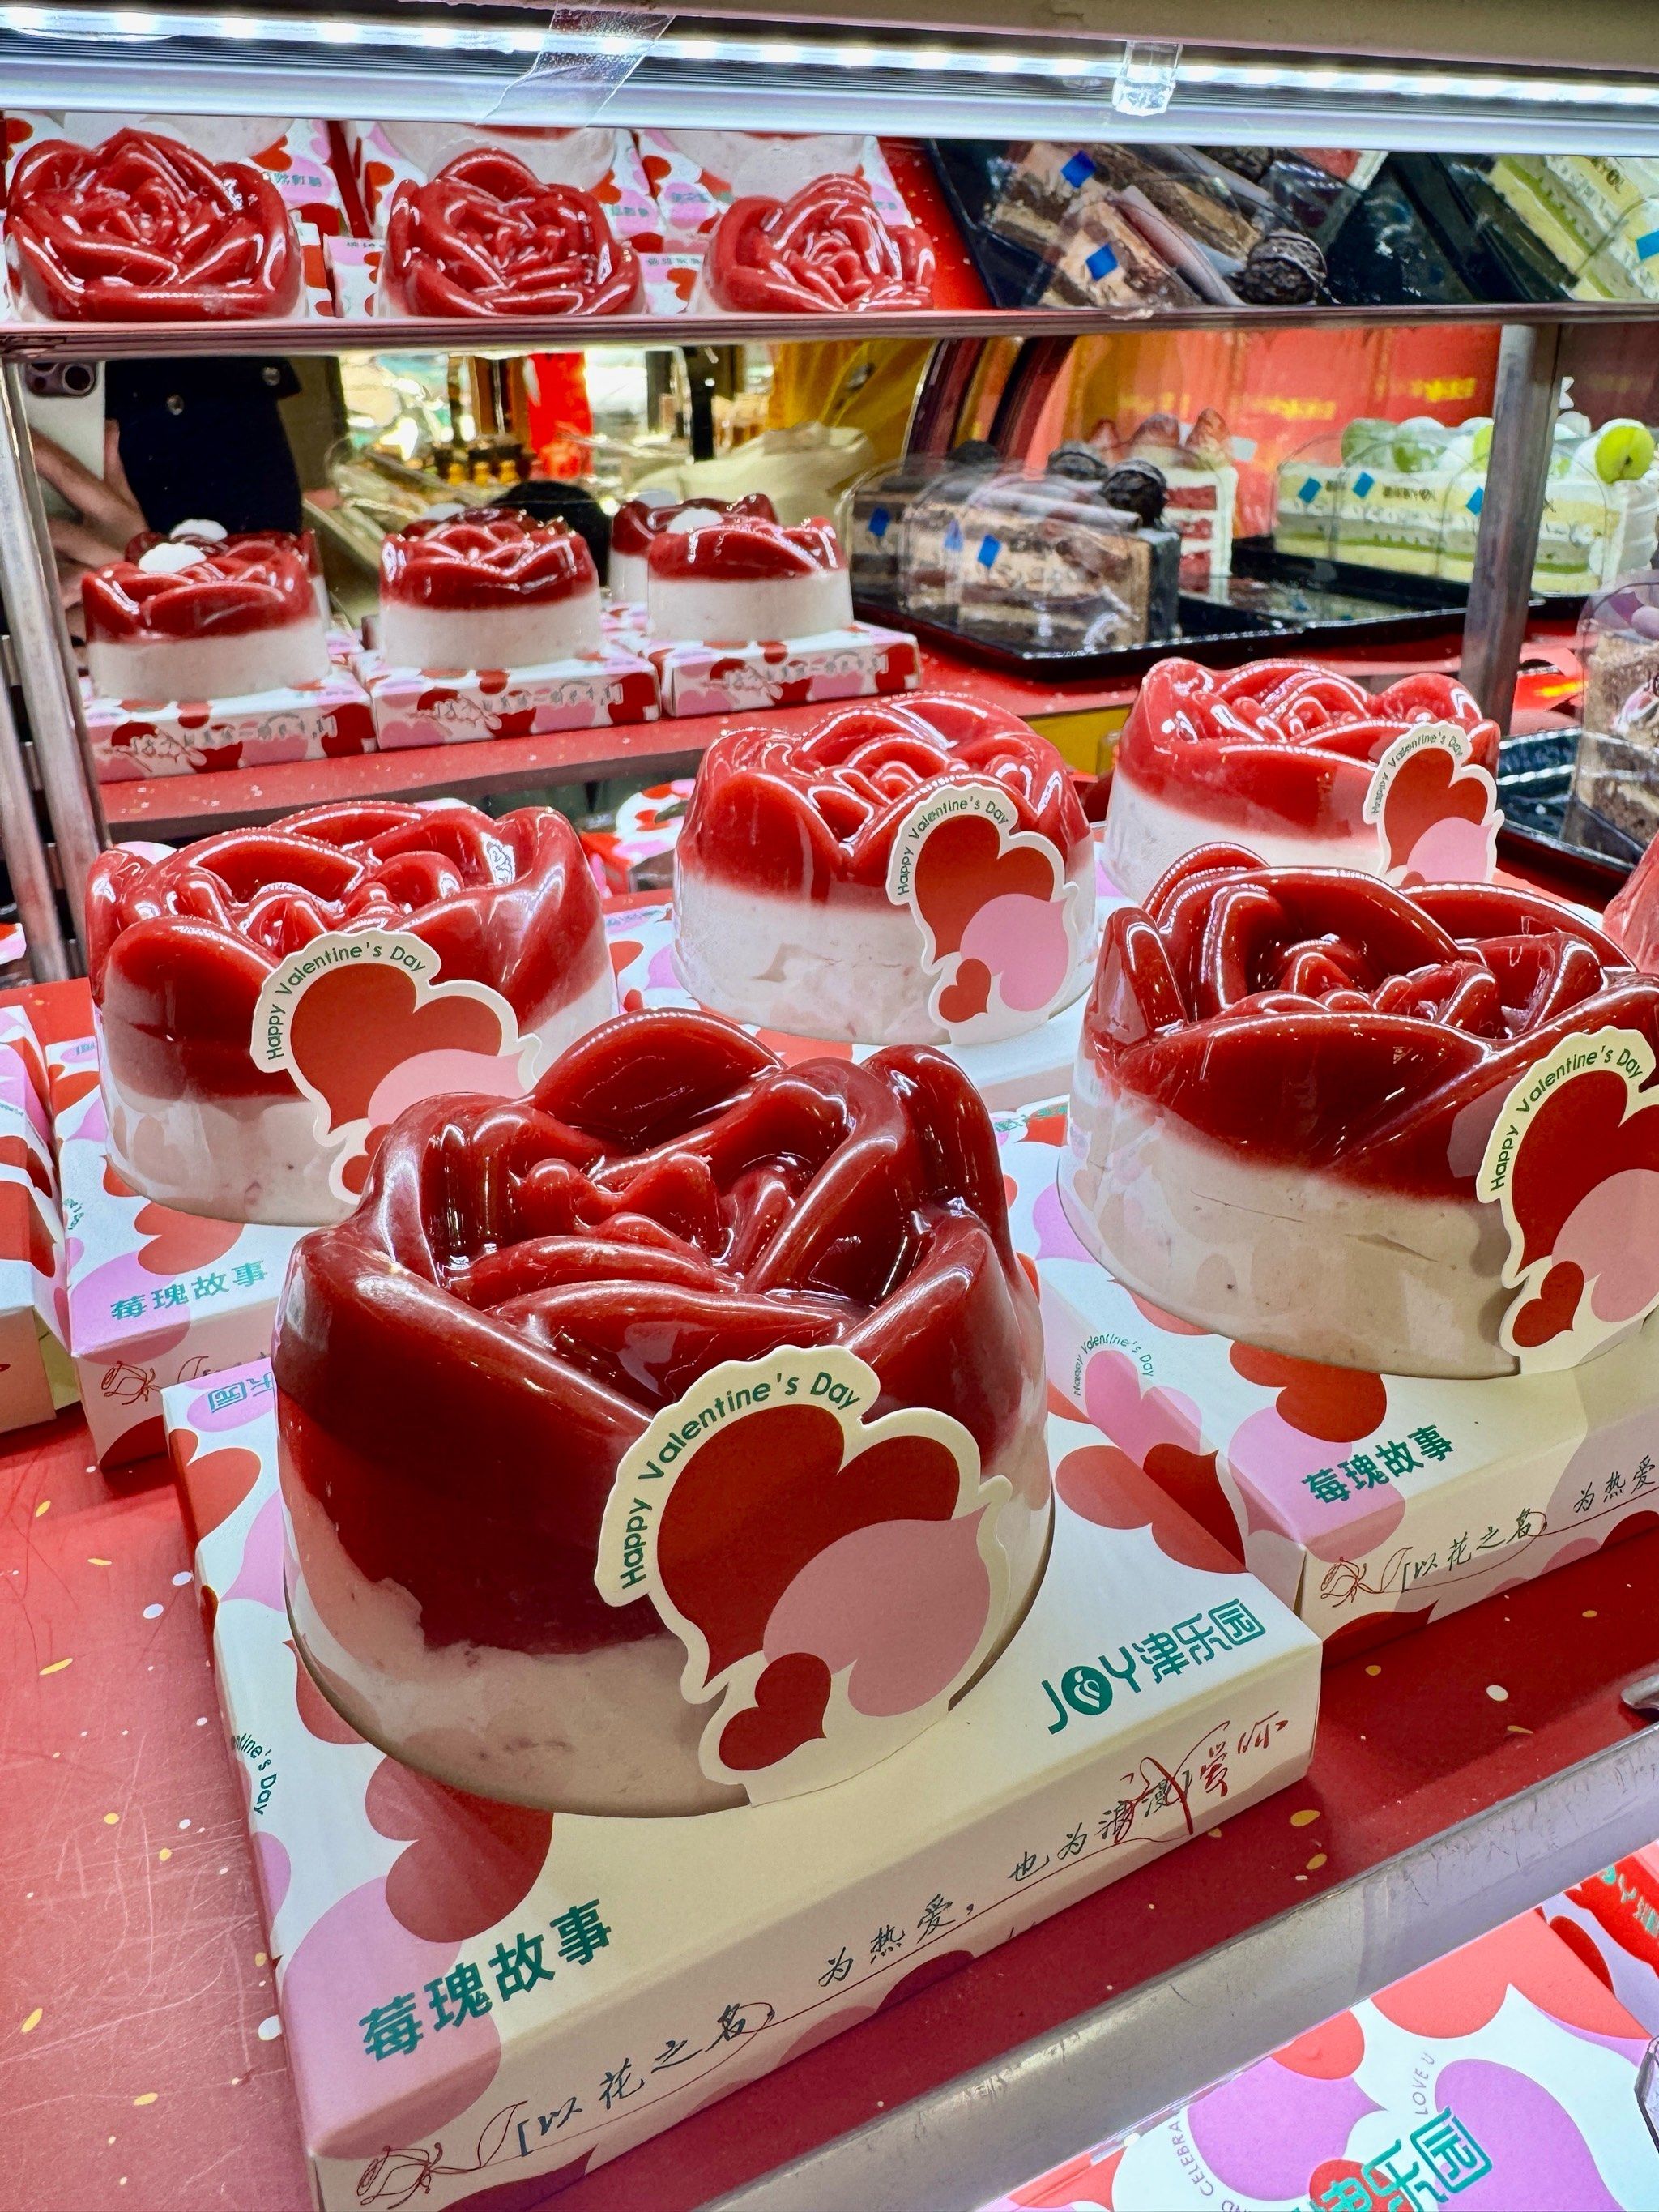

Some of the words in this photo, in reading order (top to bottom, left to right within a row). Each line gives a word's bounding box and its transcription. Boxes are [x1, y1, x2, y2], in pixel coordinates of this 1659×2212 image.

[898, 846, 915, 895] Happy
[908, 796, 981, 839] Valentine's
[985, 801, 1009, 825] Day
[275, 942, 382, 995] Valentine's
[390, 946, 426, 972] Day
[267, 1004, 286, 1060] Happy
[1490, 1125, 1519, 1192] Happy
[1516, 1045, 1614, 1112] Valentine's
[1616, 1048, 1644, 1079] Day
[110, 1260, 268, 1320] 莓瑰故事
[1139, 1354, 1154, 1377] Day
[620, 1497, 653, 1589] Happy
[638, 1373, 800, 1480] Valentine's
[810, 1371, 861, 1411] Day
[1301, 1424, 1454, 1504] 莓瑰故事
[254, 1774, 278, 1816] Day
[359, 1898, 612, 2062] 莓瑰故事
[1420, 2051, 1435, 2065] U
[1412, 2068, 1429, 2115] LOVE
